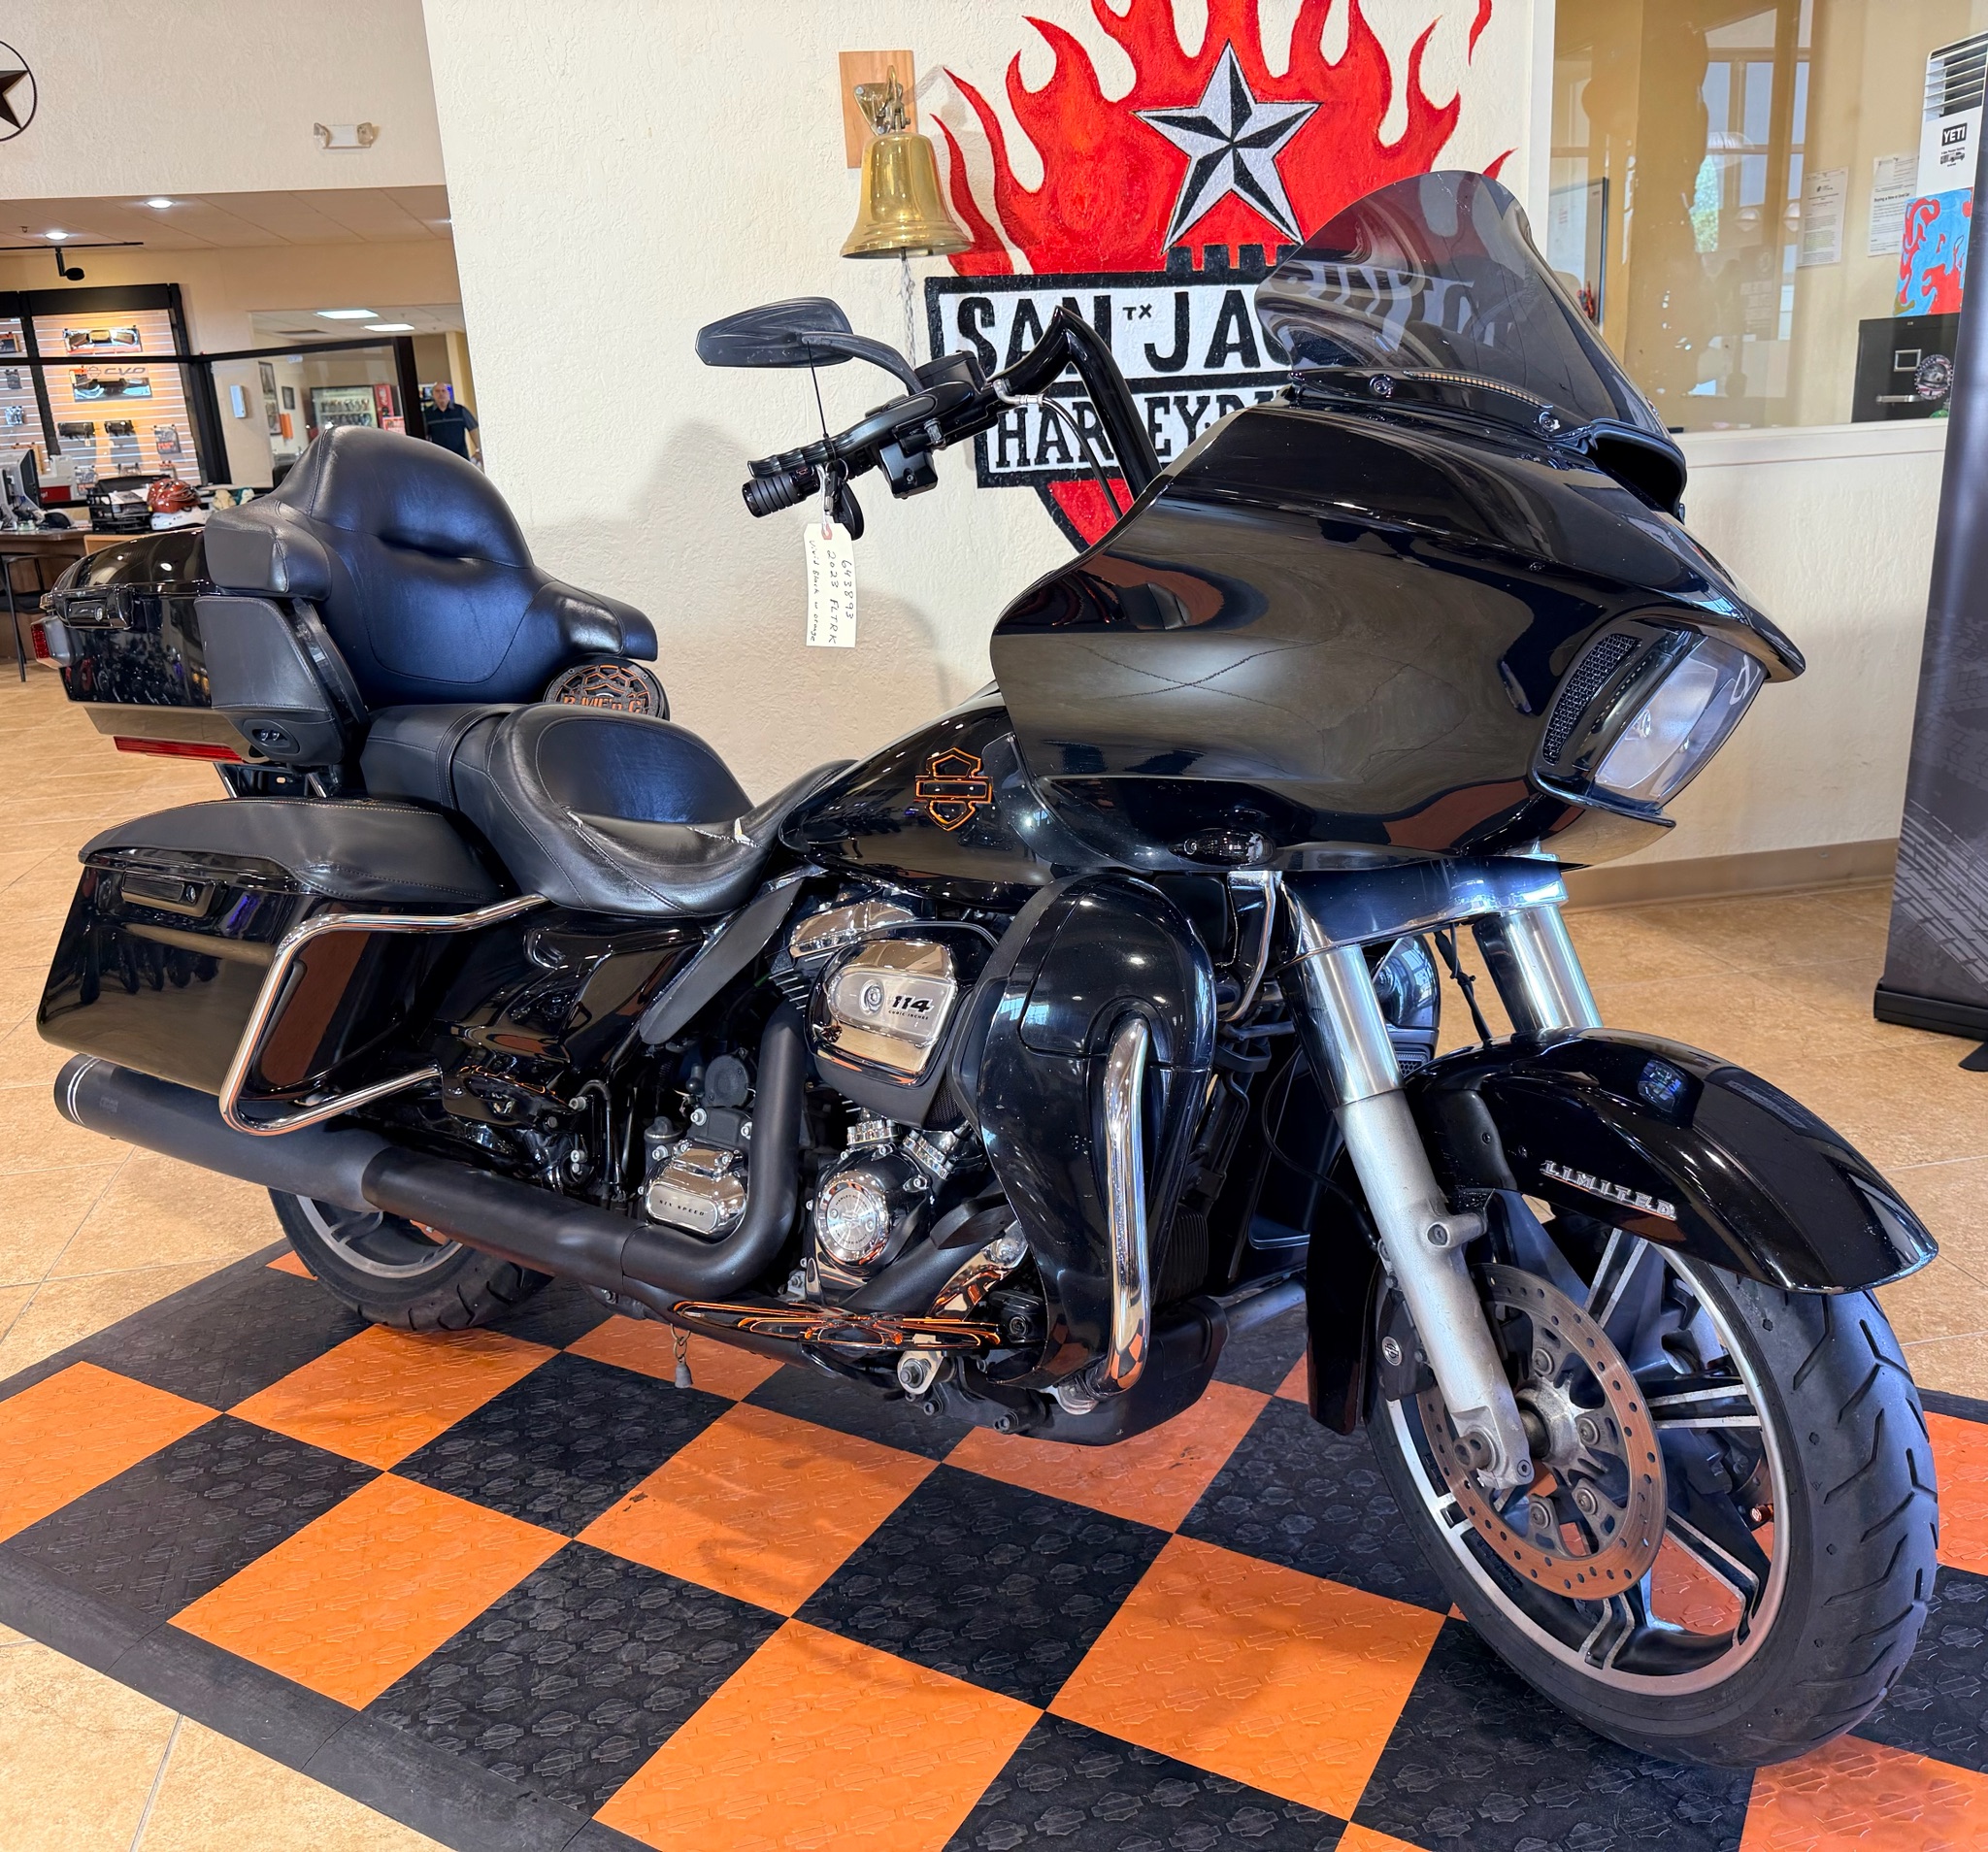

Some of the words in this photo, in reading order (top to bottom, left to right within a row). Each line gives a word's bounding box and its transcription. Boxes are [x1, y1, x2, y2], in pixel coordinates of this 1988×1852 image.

[1943, 126, 1966, 144] YETI
[1123, 304, 1152, 320] TX
[827, 550, 839, 588] 2023
[842, 560, 853, 619] 643893
[829, 599, 839, 644] FLTRK
[890, 995, 933, 1014] 114
[1540, 1160, 1677, 1220] LIMITED
[678, 1205, 705, 1216] SPEED
